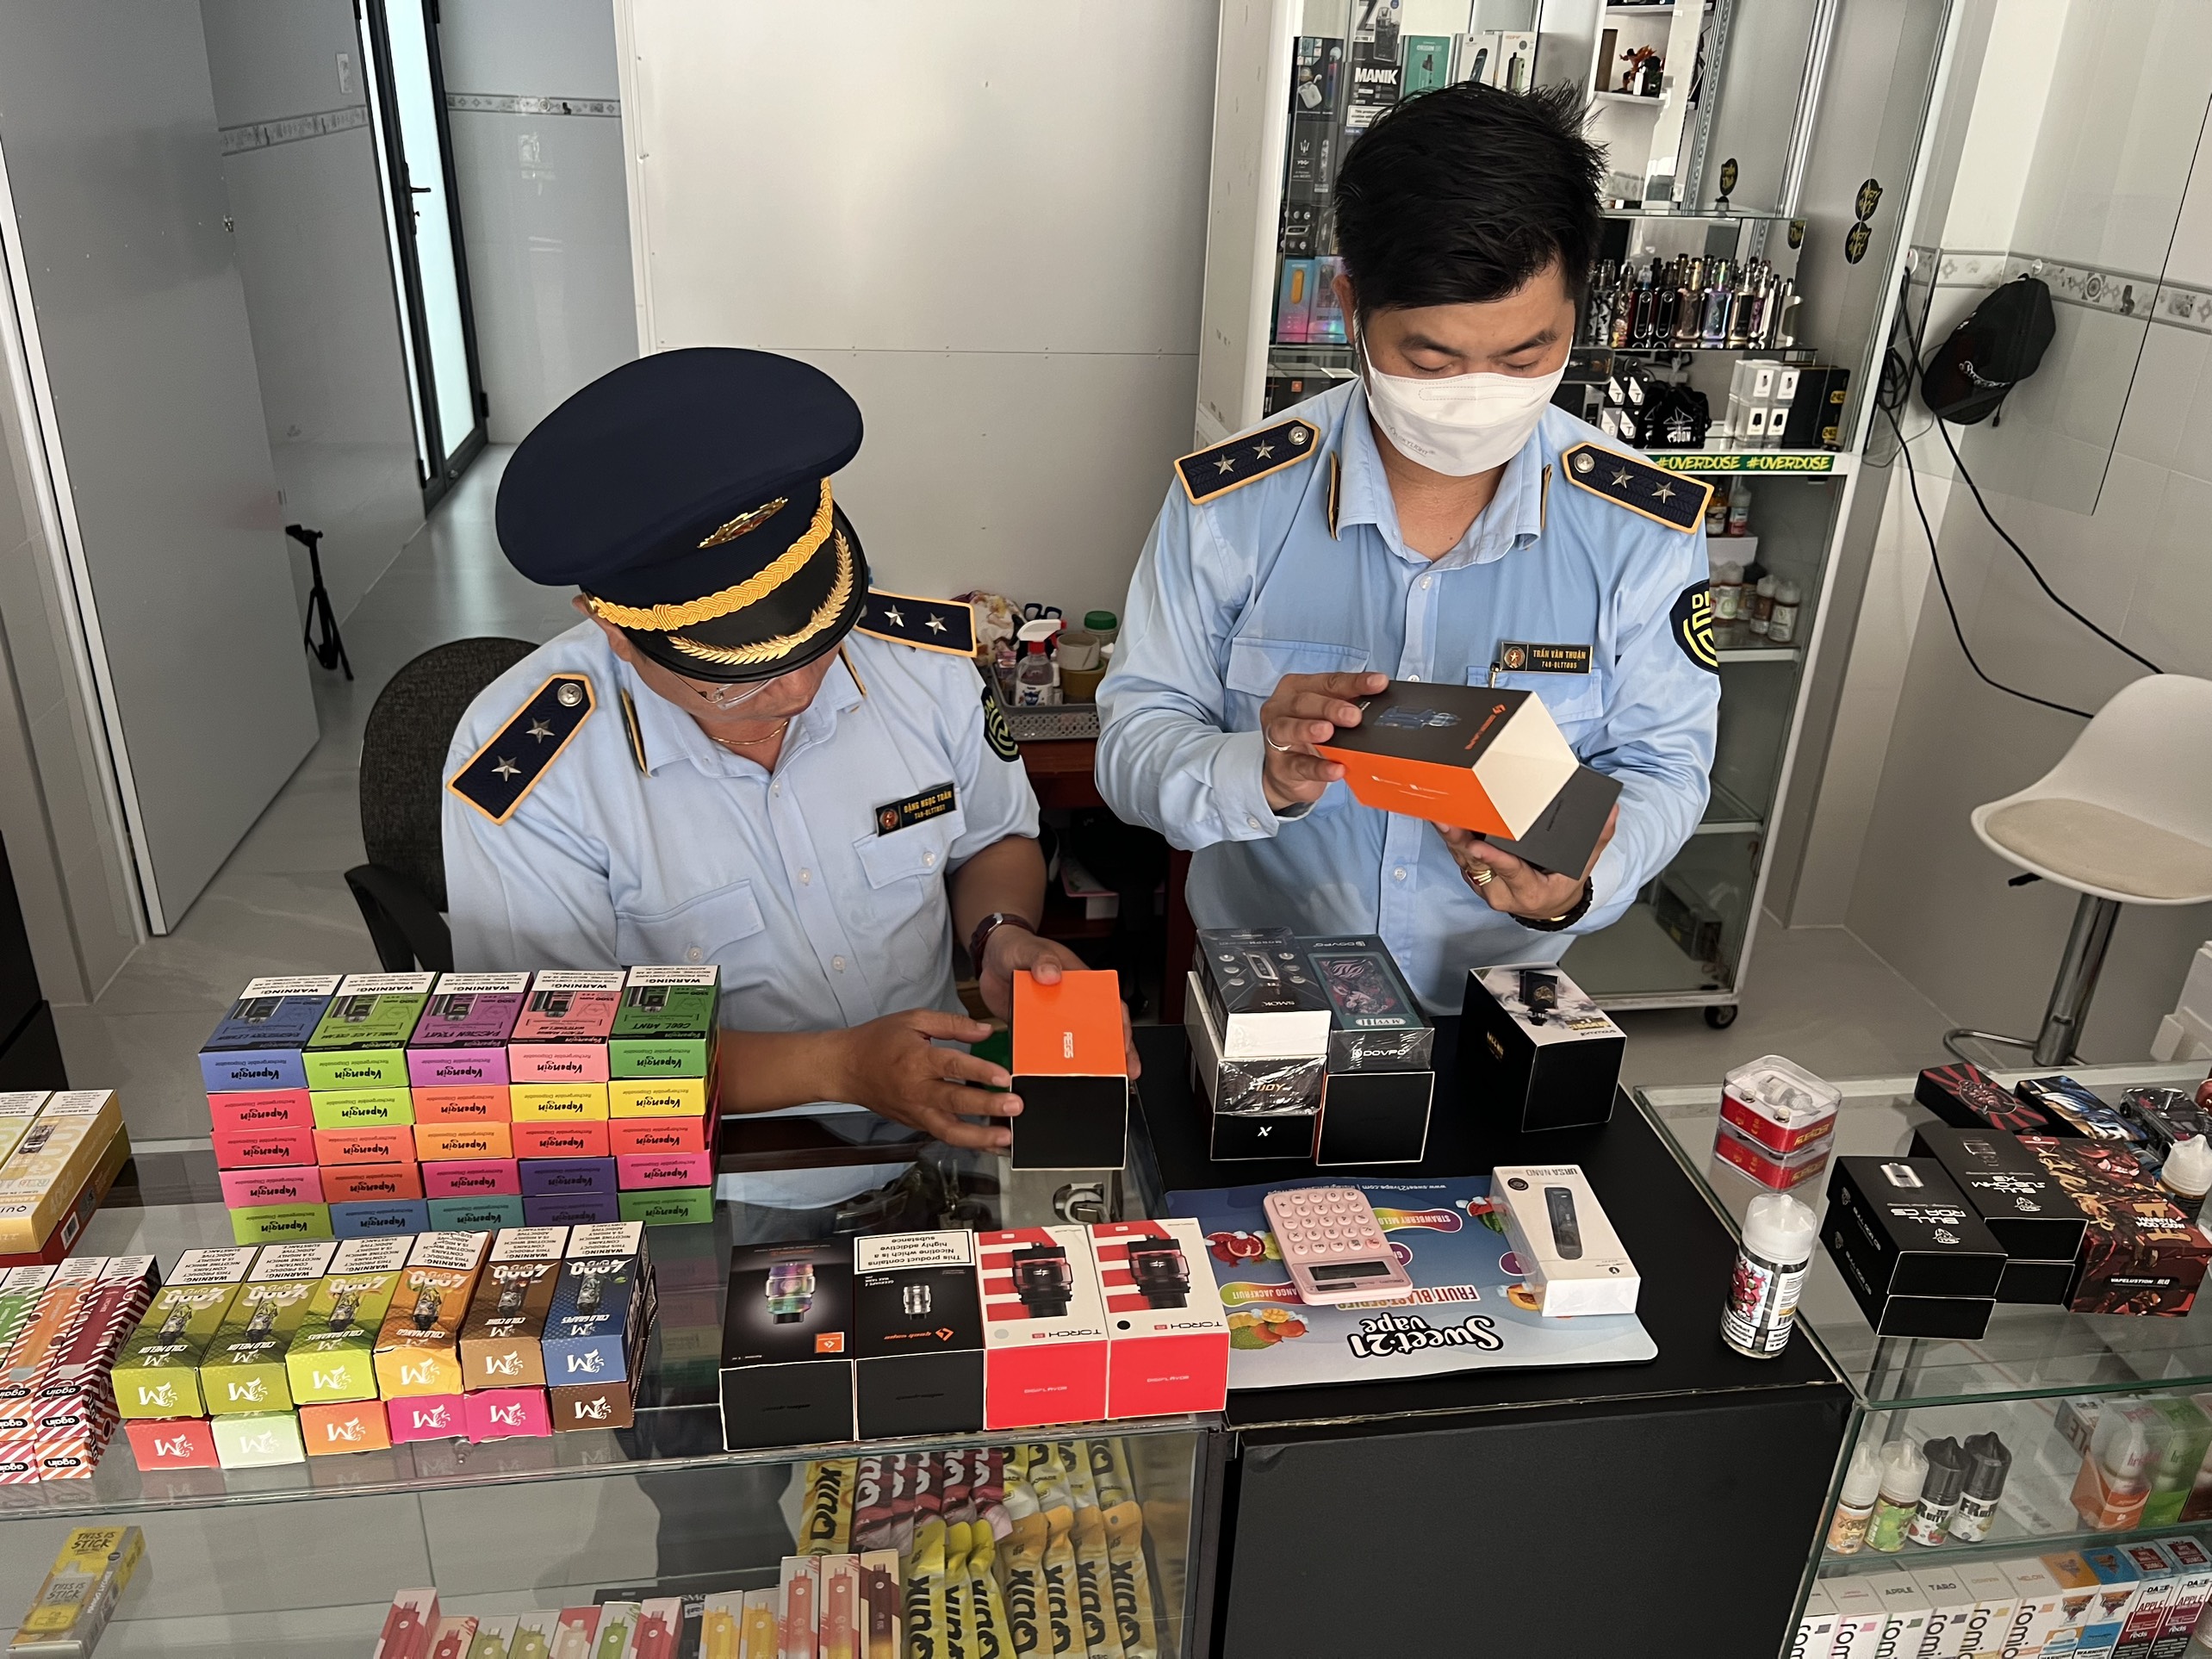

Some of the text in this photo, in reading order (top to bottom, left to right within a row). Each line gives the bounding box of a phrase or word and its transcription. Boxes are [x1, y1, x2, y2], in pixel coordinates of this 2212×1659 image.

[1354, 67, 1399, 85] MANIK
[1656, 456, 1830, 470] #OVERDOSE #OVERDOSE
[538, 1101, 583, 1113] Vapengin
[637, 1096, 680, 1108] Vapengin
[342, 1107, 388, 1118] Vapengin
[441, 1103, 487, 1115] Vapengin
[442, 1140, 487, 1151] Vapengin
[539, 1137, 584, 1149] Vapengin
[637, 1134, 680, 1146] Vapengin
[243, 1146, 289, 1158] Vapengin
[344, 1144, 388, 1155] Vapengin
[644, 1168, 688, 1179] Vapengin
[350, 1182, 395, 1193] Vapengin
[450, 1177, 496, 1189] Vapengin
[250, 1186, 296, 1197] Vapengin
[646, 1205, 689, 1217] Vapengin
[1924, 1209, 1967, 1217] RDA
[360, 1217, 406, 1227] Vapengin
[457, 1213, 501, 1224] Vapengin
[1400, 1215, 1451, 1227] STRAWBERRY
[261, 1221, 308, 1233] Vapengin
[424, 1258, 467, 1267] WARNING:
[911, 1254, 941, 1264] product
[494, 1264, 551, 1279] 4000
[569, 1258, 624, 1276] 4000
[328, 1276, 388, 1292] 4000
[405, 1270, 471, 1288] 4000
[248, 1283, 308, 1301] 4000
[1232, 1289, 1274, 1299] JACKFRUIT
[1436, 1287, 1477, 1302] FRUIT
[561, 1314, 611, 1325] COLD GRAPES
[1361, 1313, 1427, 1333] vape
[1170, 1321, 1223, 1330] TORCH
[339, 1329, 364, 1338] COLD
[396, 1328, 445, 1339] COLD MANGO
[1048, 1329, 1102, 1338] TORCH
[137, 1344, 189, 1354] COLD MELON
[226, 1341, 276, 1351] COLD MELON
[47, 1386, 77, 1396] again
[46, 1417, 76, 1426] again
[47, 1457, 77, 1467] again
[810, 1466, 842, 1539] QUIX
[71, 1538, 111, 1550] STICK
[47, 1589, 82, 1600] STICK
[1886, 1587, 1914, 1595] APPLE
[2147, 1585, 2170, 1594] DAZE
[1077, 1561, 1106, 1647] QUIX
[2179, 1594, 2204, 1604] APPLE
[1045, 1564, 1071, 1654] QUIX
[1110, 1561, 1140, 1651] QUIX
[2139, 1600, 2165, 1611] APPLE
[1008, 1569, 1038, 1654] QUIX
[2168, 1625, 2187, 1633] reds
